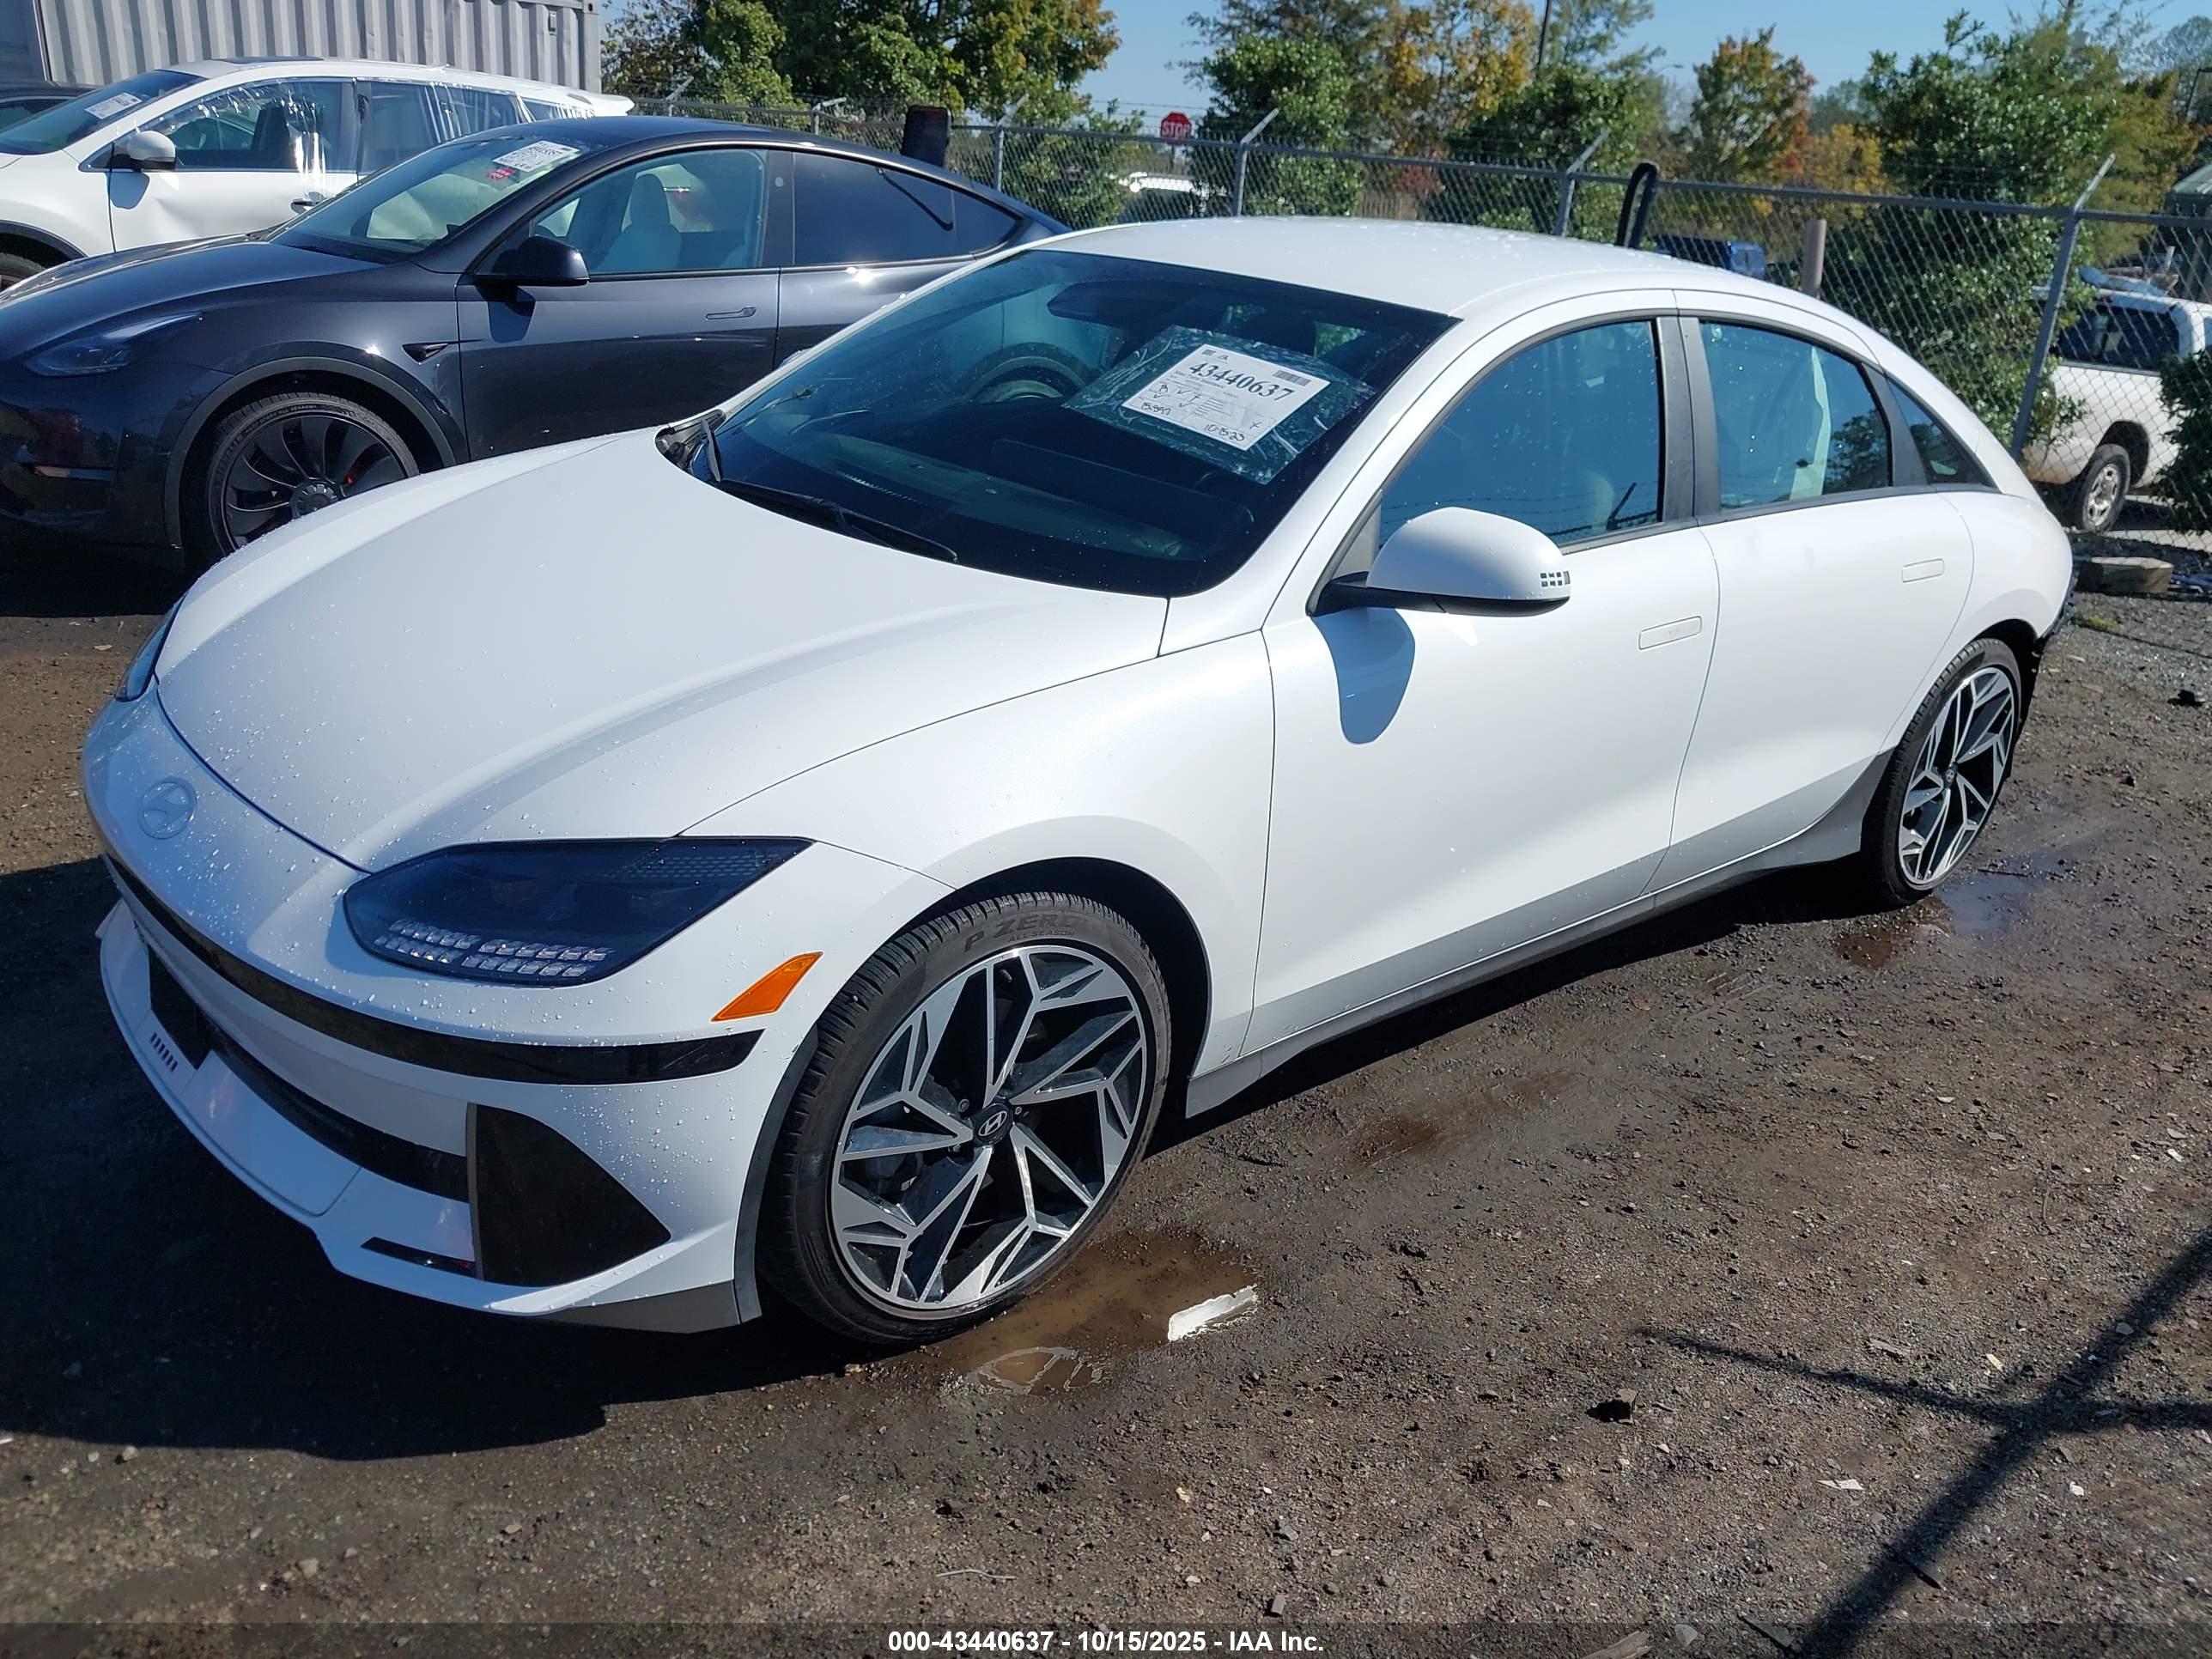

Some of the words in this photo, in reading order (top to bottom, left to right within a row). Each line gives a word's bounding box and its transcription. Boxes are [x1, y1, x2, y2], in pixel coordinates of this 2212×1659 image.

[1162, 122, 1190, 138] STOP
[1189, 362, 1296, 401] 43440637
[964, 930, 985, 952] P
[994, 914, 1081, 939] ZERO
[1008, 933, 1029, 943] ALL
